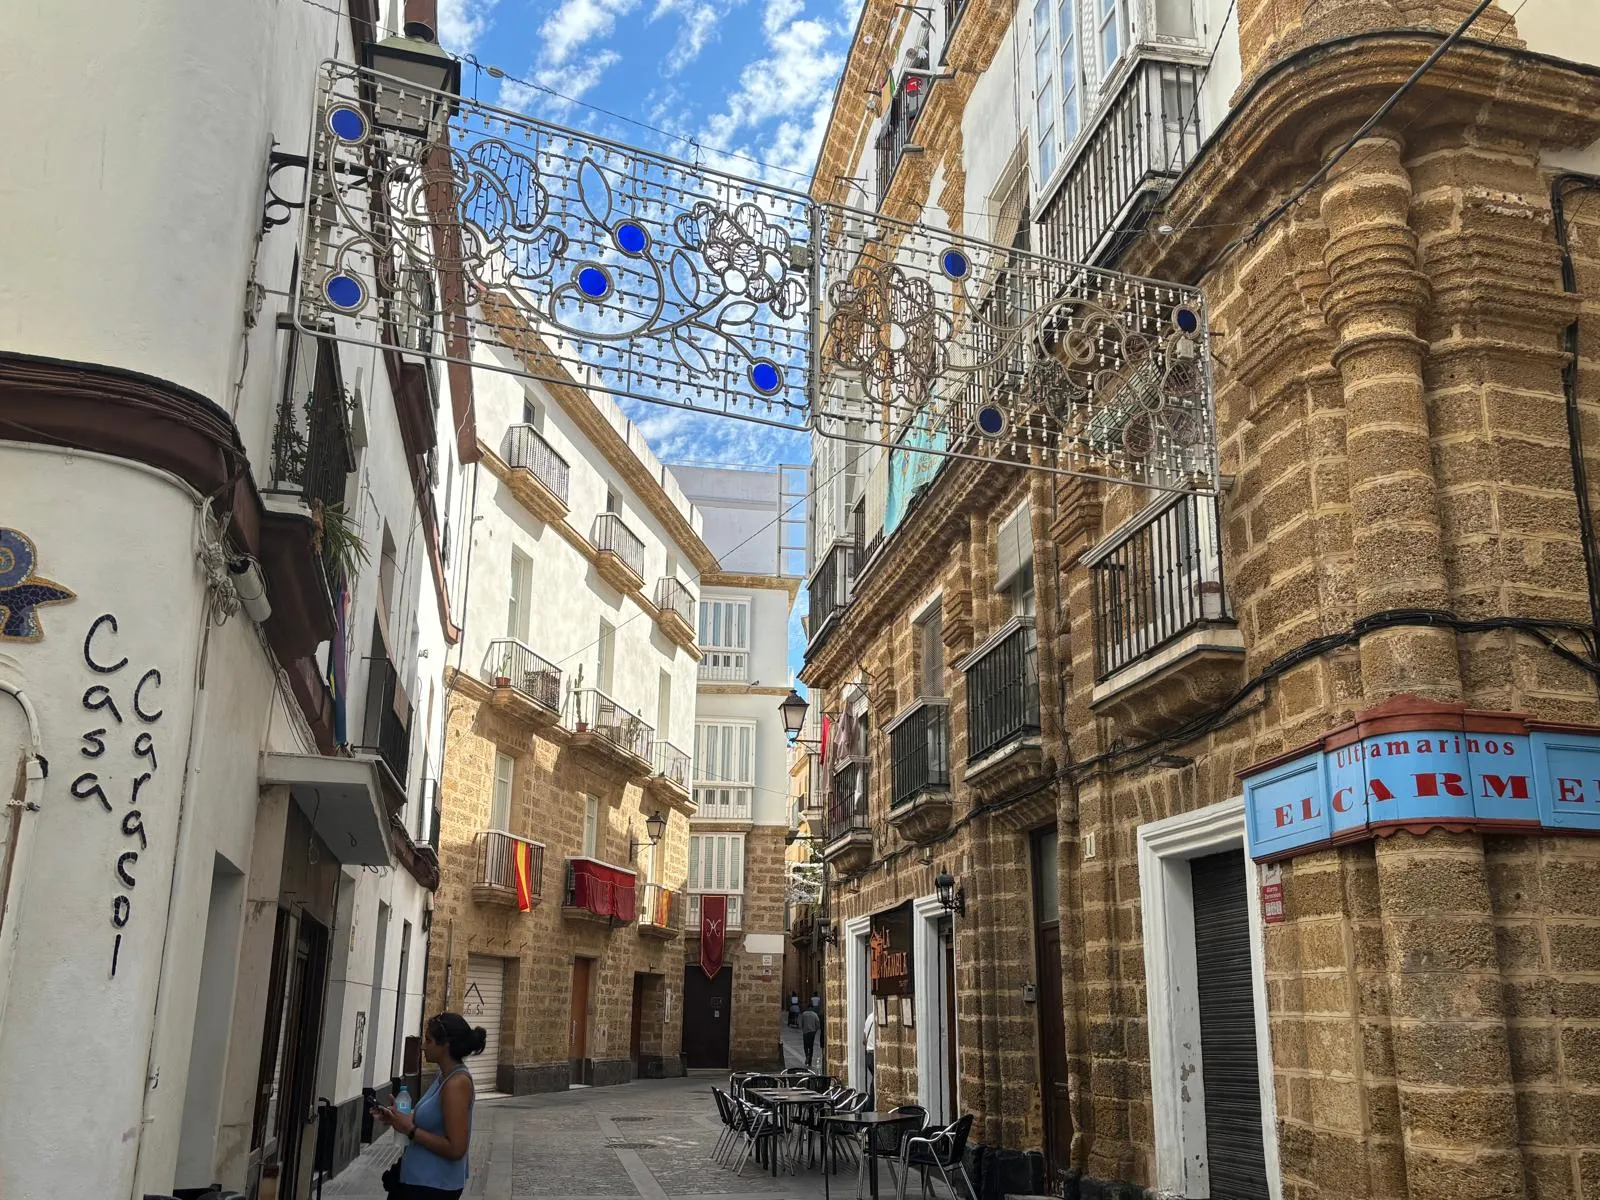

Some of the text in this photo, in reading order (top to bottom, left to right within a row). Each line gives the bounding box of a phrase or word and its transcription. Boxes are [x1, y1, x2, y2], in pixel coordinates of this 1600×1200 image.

[71, 613, 128, 812] Casa
[1337, 735, 1515, 769] Ultramarinos
[109, 669, 163, 977] Caracol
[1274, 772, 1600, 829] EL CARME
